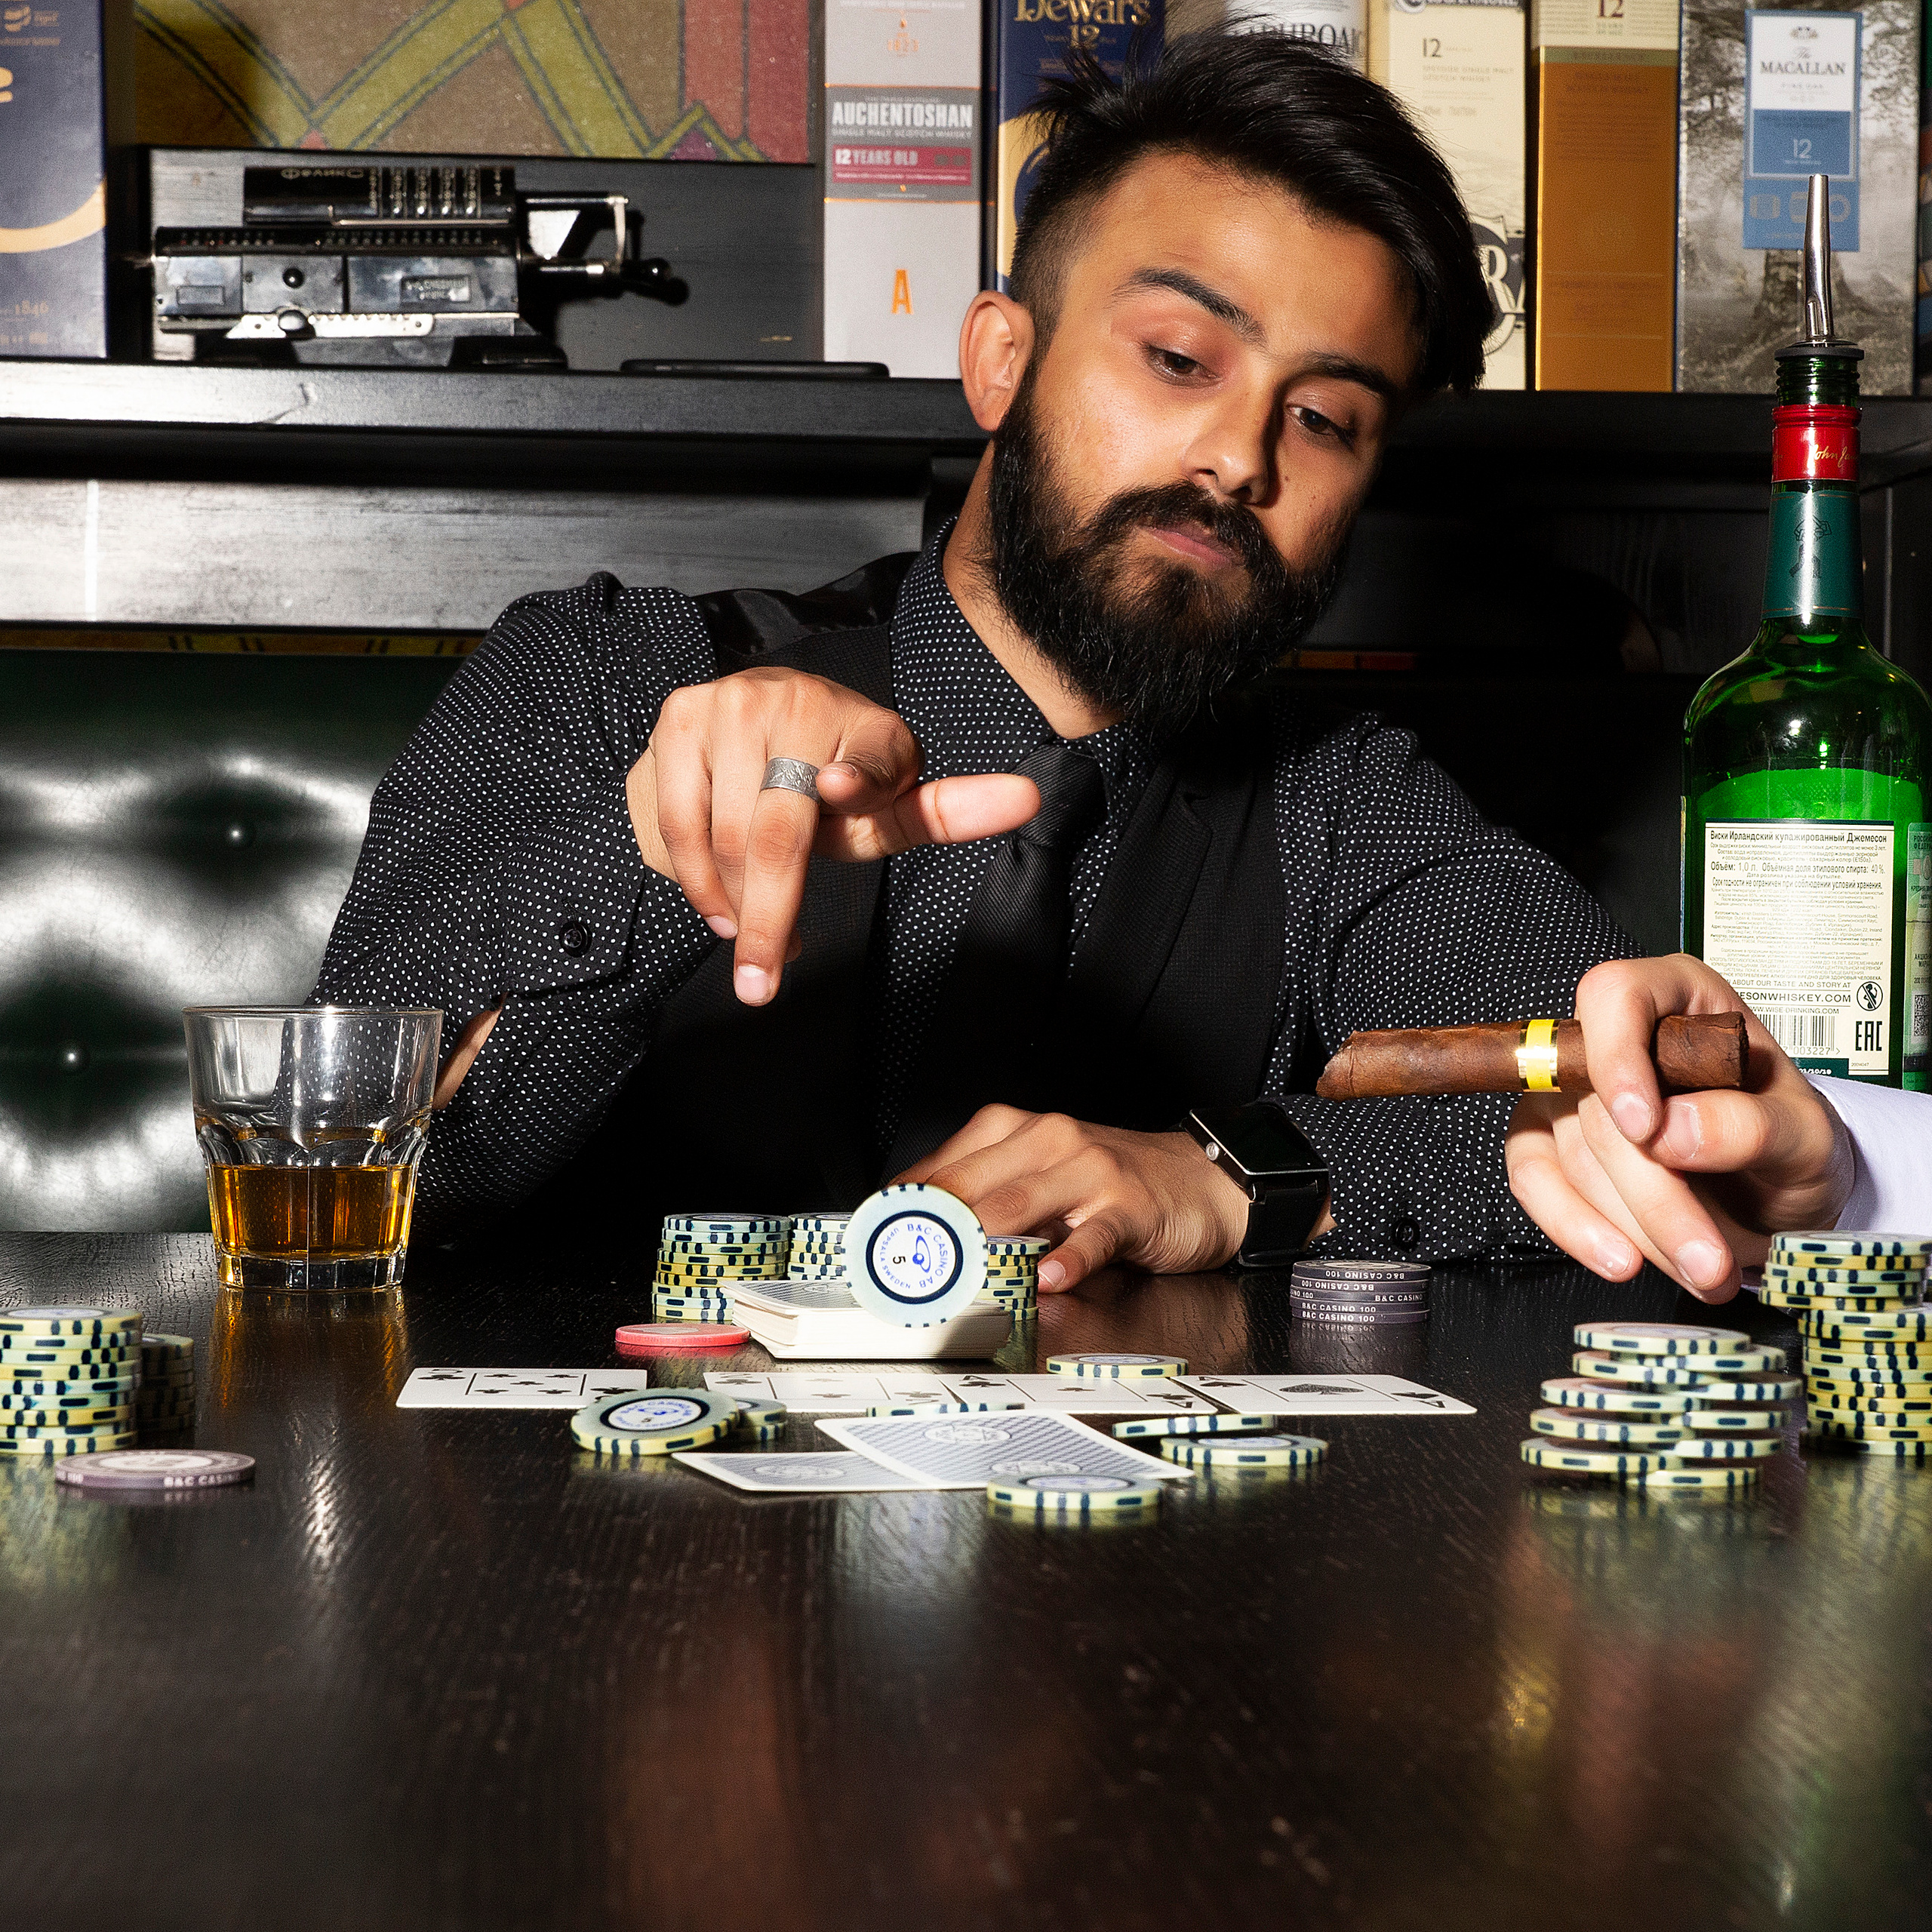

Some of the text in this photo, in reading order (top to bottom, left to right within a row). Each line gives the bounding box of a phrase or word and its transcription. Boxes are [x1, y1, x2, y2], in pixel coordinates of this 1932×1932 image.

[1068, 24, 1100, 50] 12
[1423, 38, 1442, 58] 12
[1760, 61, 1847, 75] MACALLAN
[832, 101, 974, 128] AUCHENTOSHAN
[1793, 139, 1812, 159] 12
[835, 149, 918, 166] 12 YEARS OLD
[891, 269, 914, 315] A
[1711, 830, 1887, 844] Виски Ирландский купажированный Джемесон
[1711, 861, 1736, 871] Объём:
[1739, 862, 1749, 872] 1,0
[1751, 863, 1758, 872] л.
[1762, 862, 1794, 872] Объёмная
[1846, 866, 1869, 875] спирта:
[1712, 877, 1723, 888] Срок
[1753, 879, 1781, 888] ограничен
[1783, 881, 1793, 890] при
[1795, 879, 1831, 889] соблюдении
[1832, 879, 1856, 891] условий
[1857, 881, 1882, 891] хранения.
[1737, 992, 1851, 1003] ESONWHISKEY.COM
[1750, 1006, 1840, 1014] WW.WISE-DRINKING.COM
[1855, 1021, 1883, 1051] EAC
[1793, 1047, 1831, 1055] 003227
[880, 1227, 912, 1289] UPPSALA SWEDEN
[892, 1256, 906, 1265] 5
[907, 1223, 949, 1288] B&C CASINO AB
[1345, 1272, 1383, 1280] CASINO
[1315, 1281, 1349, 1291] CASINO
[1353, 1283, 1374, 1291] B&C
[1398, 1293, 1423, 1302] CASINO
[1302, 1302, 1317, 1310] B&C
[1302, 1311, 1316, 1319] B&C
[1319, 1312, 1355, 1321] CASINO
